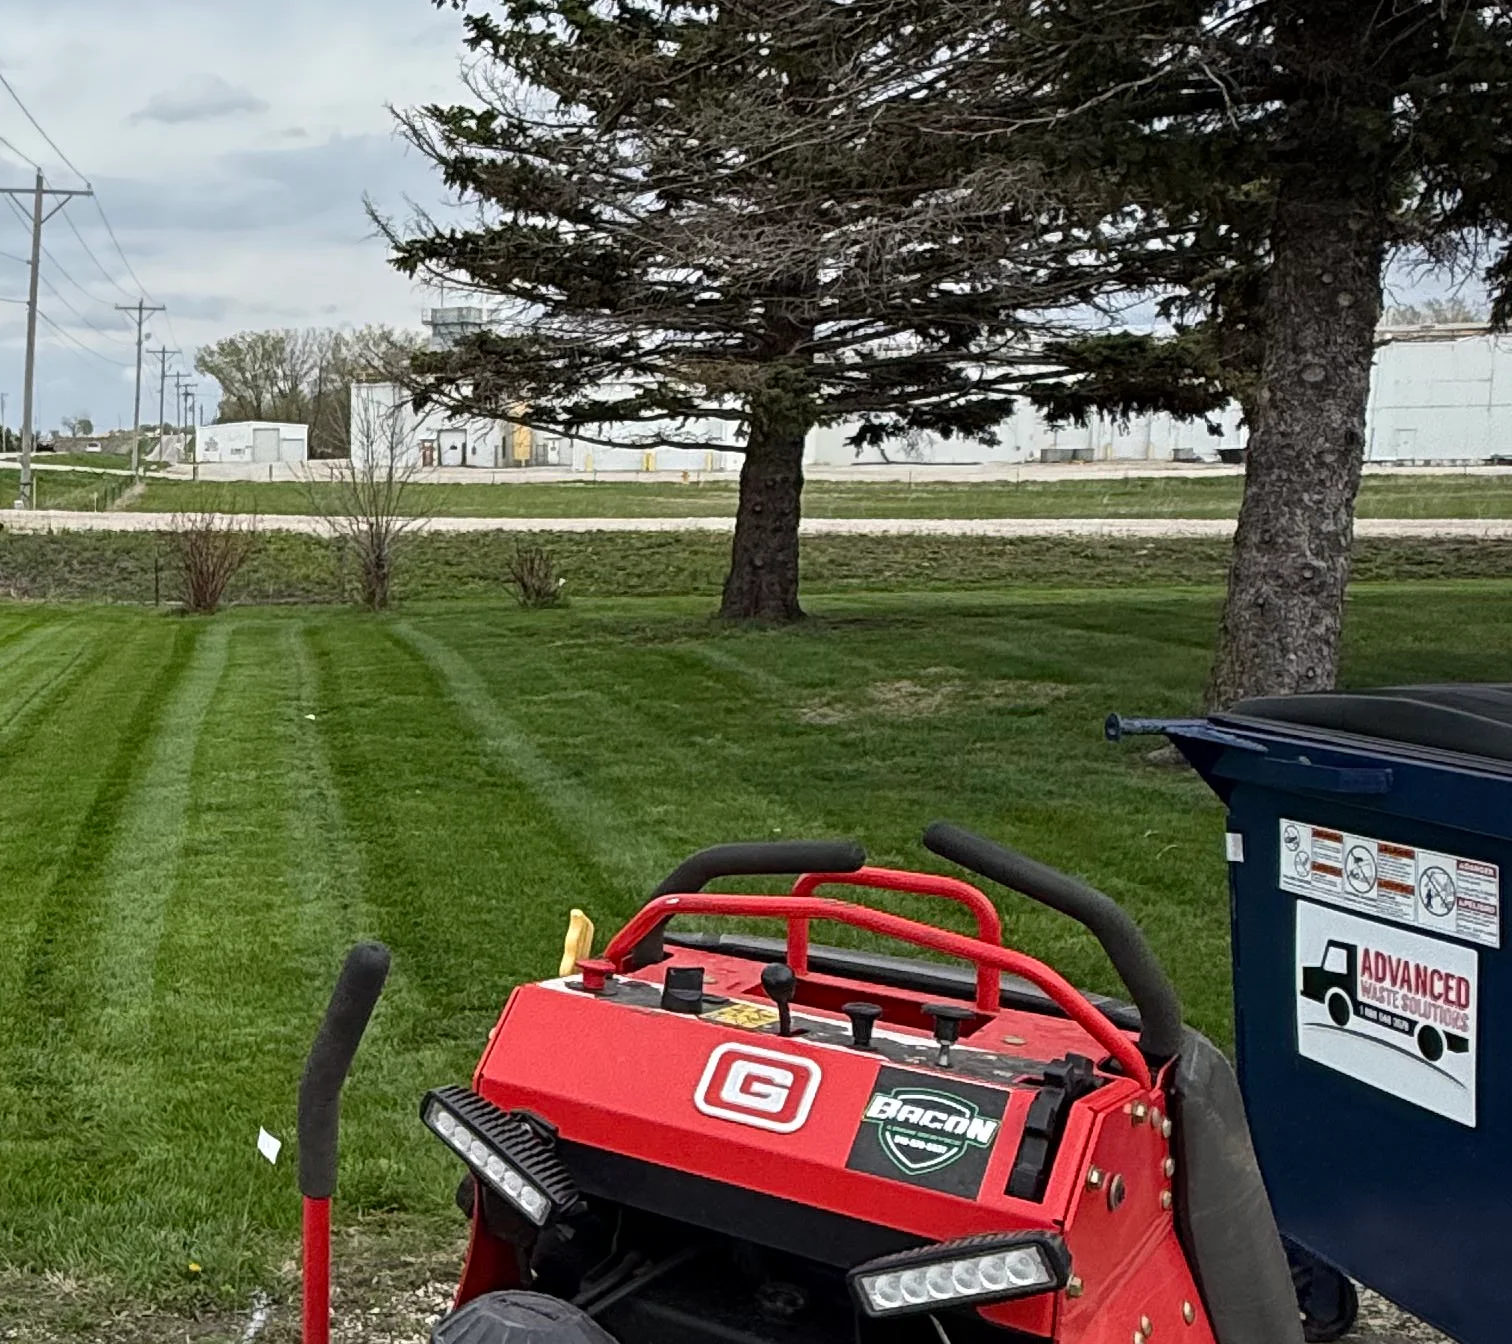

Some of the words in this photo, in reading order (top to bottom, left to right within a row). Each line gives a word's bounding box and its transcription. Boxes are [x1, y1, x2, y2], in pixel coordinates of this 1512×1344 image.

[1361, 947, 1470, 1009] ADVANCED
[1361, 979, 1399, 1009] WASTE
[1401, 993, 1470, 1032] SOLUTIONS
[720, 1060, 794, 1113] G
[866, 1095, 999, 1143] BACON
